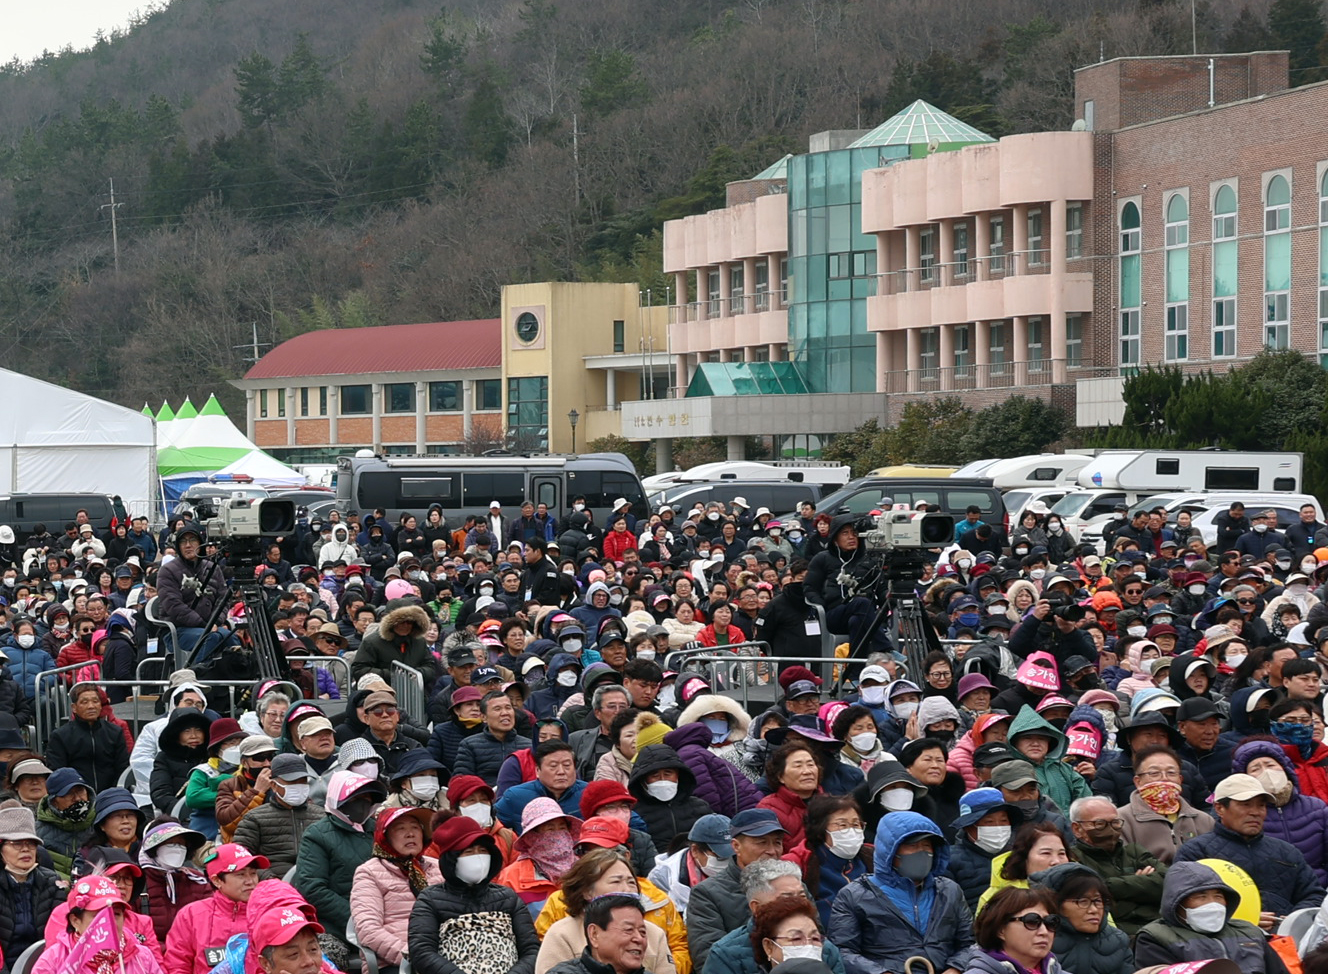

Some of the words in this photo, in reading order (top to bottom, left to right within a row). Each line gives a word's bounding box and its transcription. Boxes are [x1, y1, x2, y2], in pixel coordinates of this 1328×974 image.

[1026, 667, 1057, 684] 송가인
[95, 887, 116, 896] Again
[280, 915, 305, 926] Again
